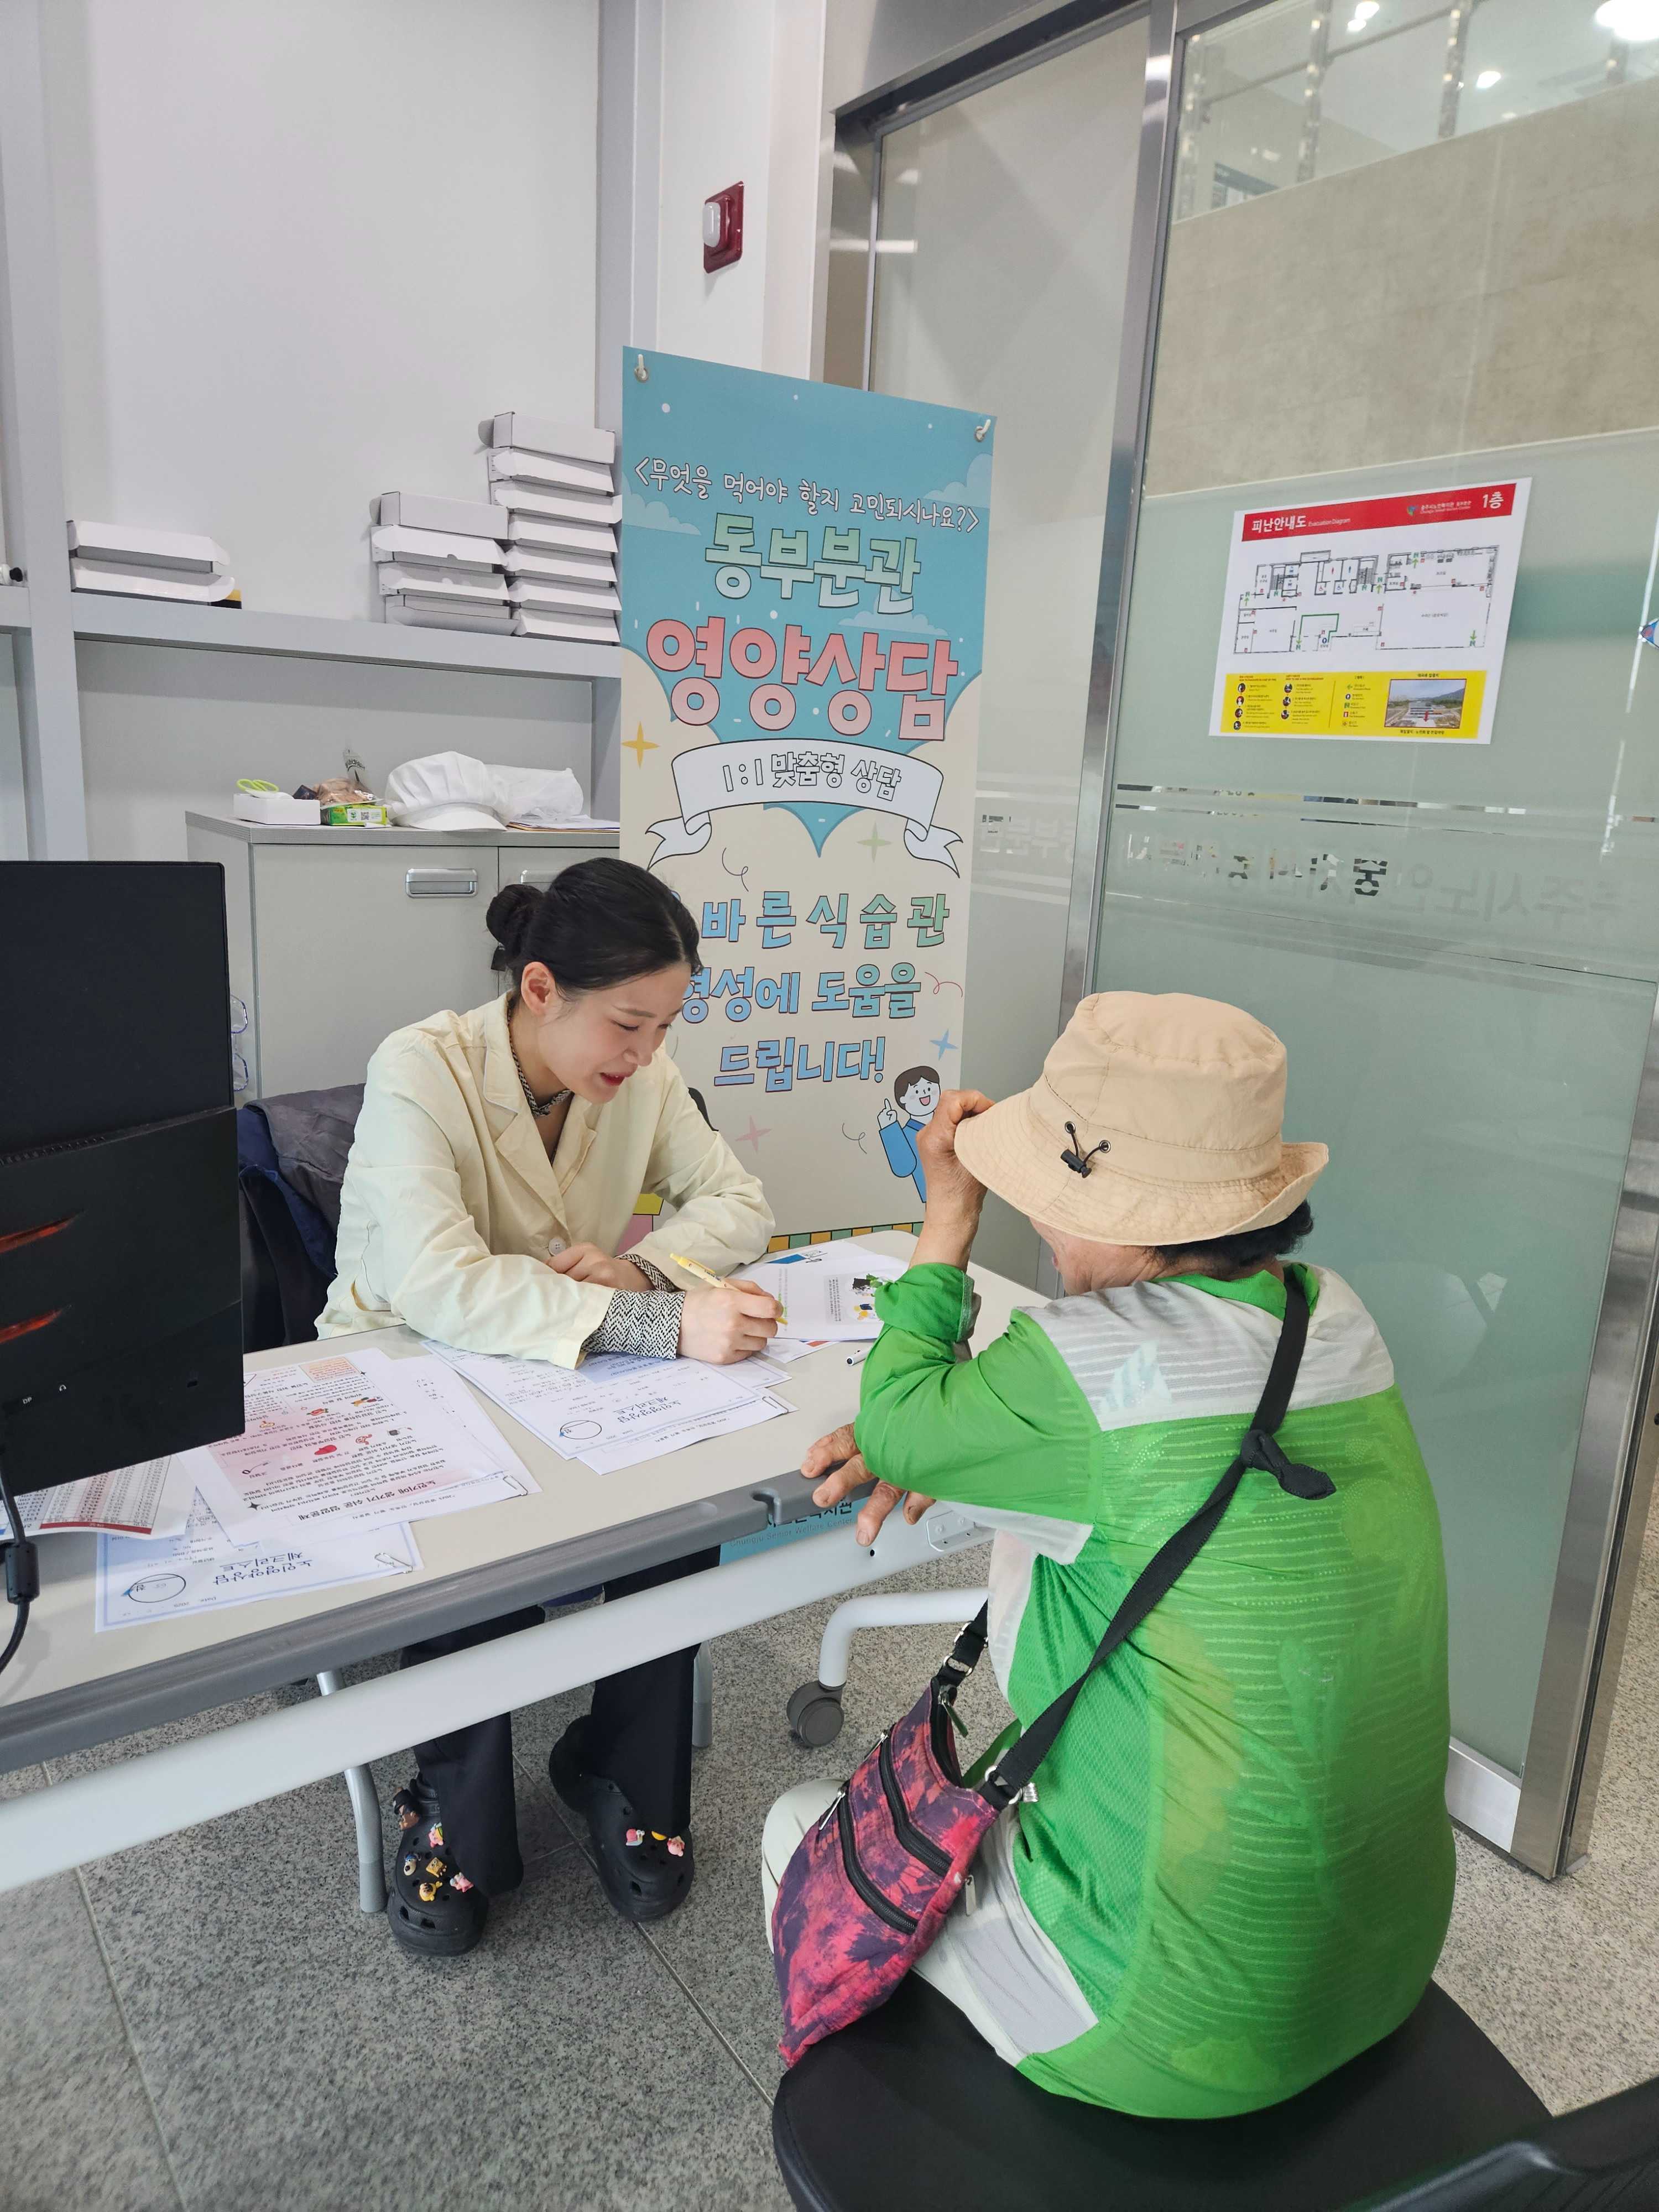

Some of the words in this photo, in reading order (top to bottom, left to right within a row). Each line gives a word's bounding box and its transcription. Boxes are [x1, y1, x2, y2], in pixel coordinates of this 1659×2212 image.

[634, 457, 712, 499] <무엇을
[724, 473, 788, 503] 먹어야
[799, 479, 839, 515] 할지
[849, 493, 980, 533] 고민되시나요?>
[1483, 492, 1504, 509] 1층
[1251, 515, 1306, 533] 피난안내도
[705, 512, 922, 615] 동부분관
[646, 615, 959, 741] 영양상담
[771, 752, 845, 789] 맞춤형
[851, 759, 902, 802] 상담
[673, 891, 796, 950] 바른
[812, 962, 921, 1019] 도움을
[714, 1037, 885, 1093] 드립니다!
[613, 1397, 668, 1415] 체크리스트
[618, 1401, 681, 1423] 노인영양상담
[366, 1491, 395, 1502] 생기기
[398, 1481, 436, 1494] 노인기에
[344, 1500, 363, 1508] 쉬운
[766, 1530, 791, 1540] Senior
[795, 1522, 823, 1533] Welfare
[214, 1561, 311, 1585] 노인영양상담
[221, 1553, 301, 1571] 체크리스트
